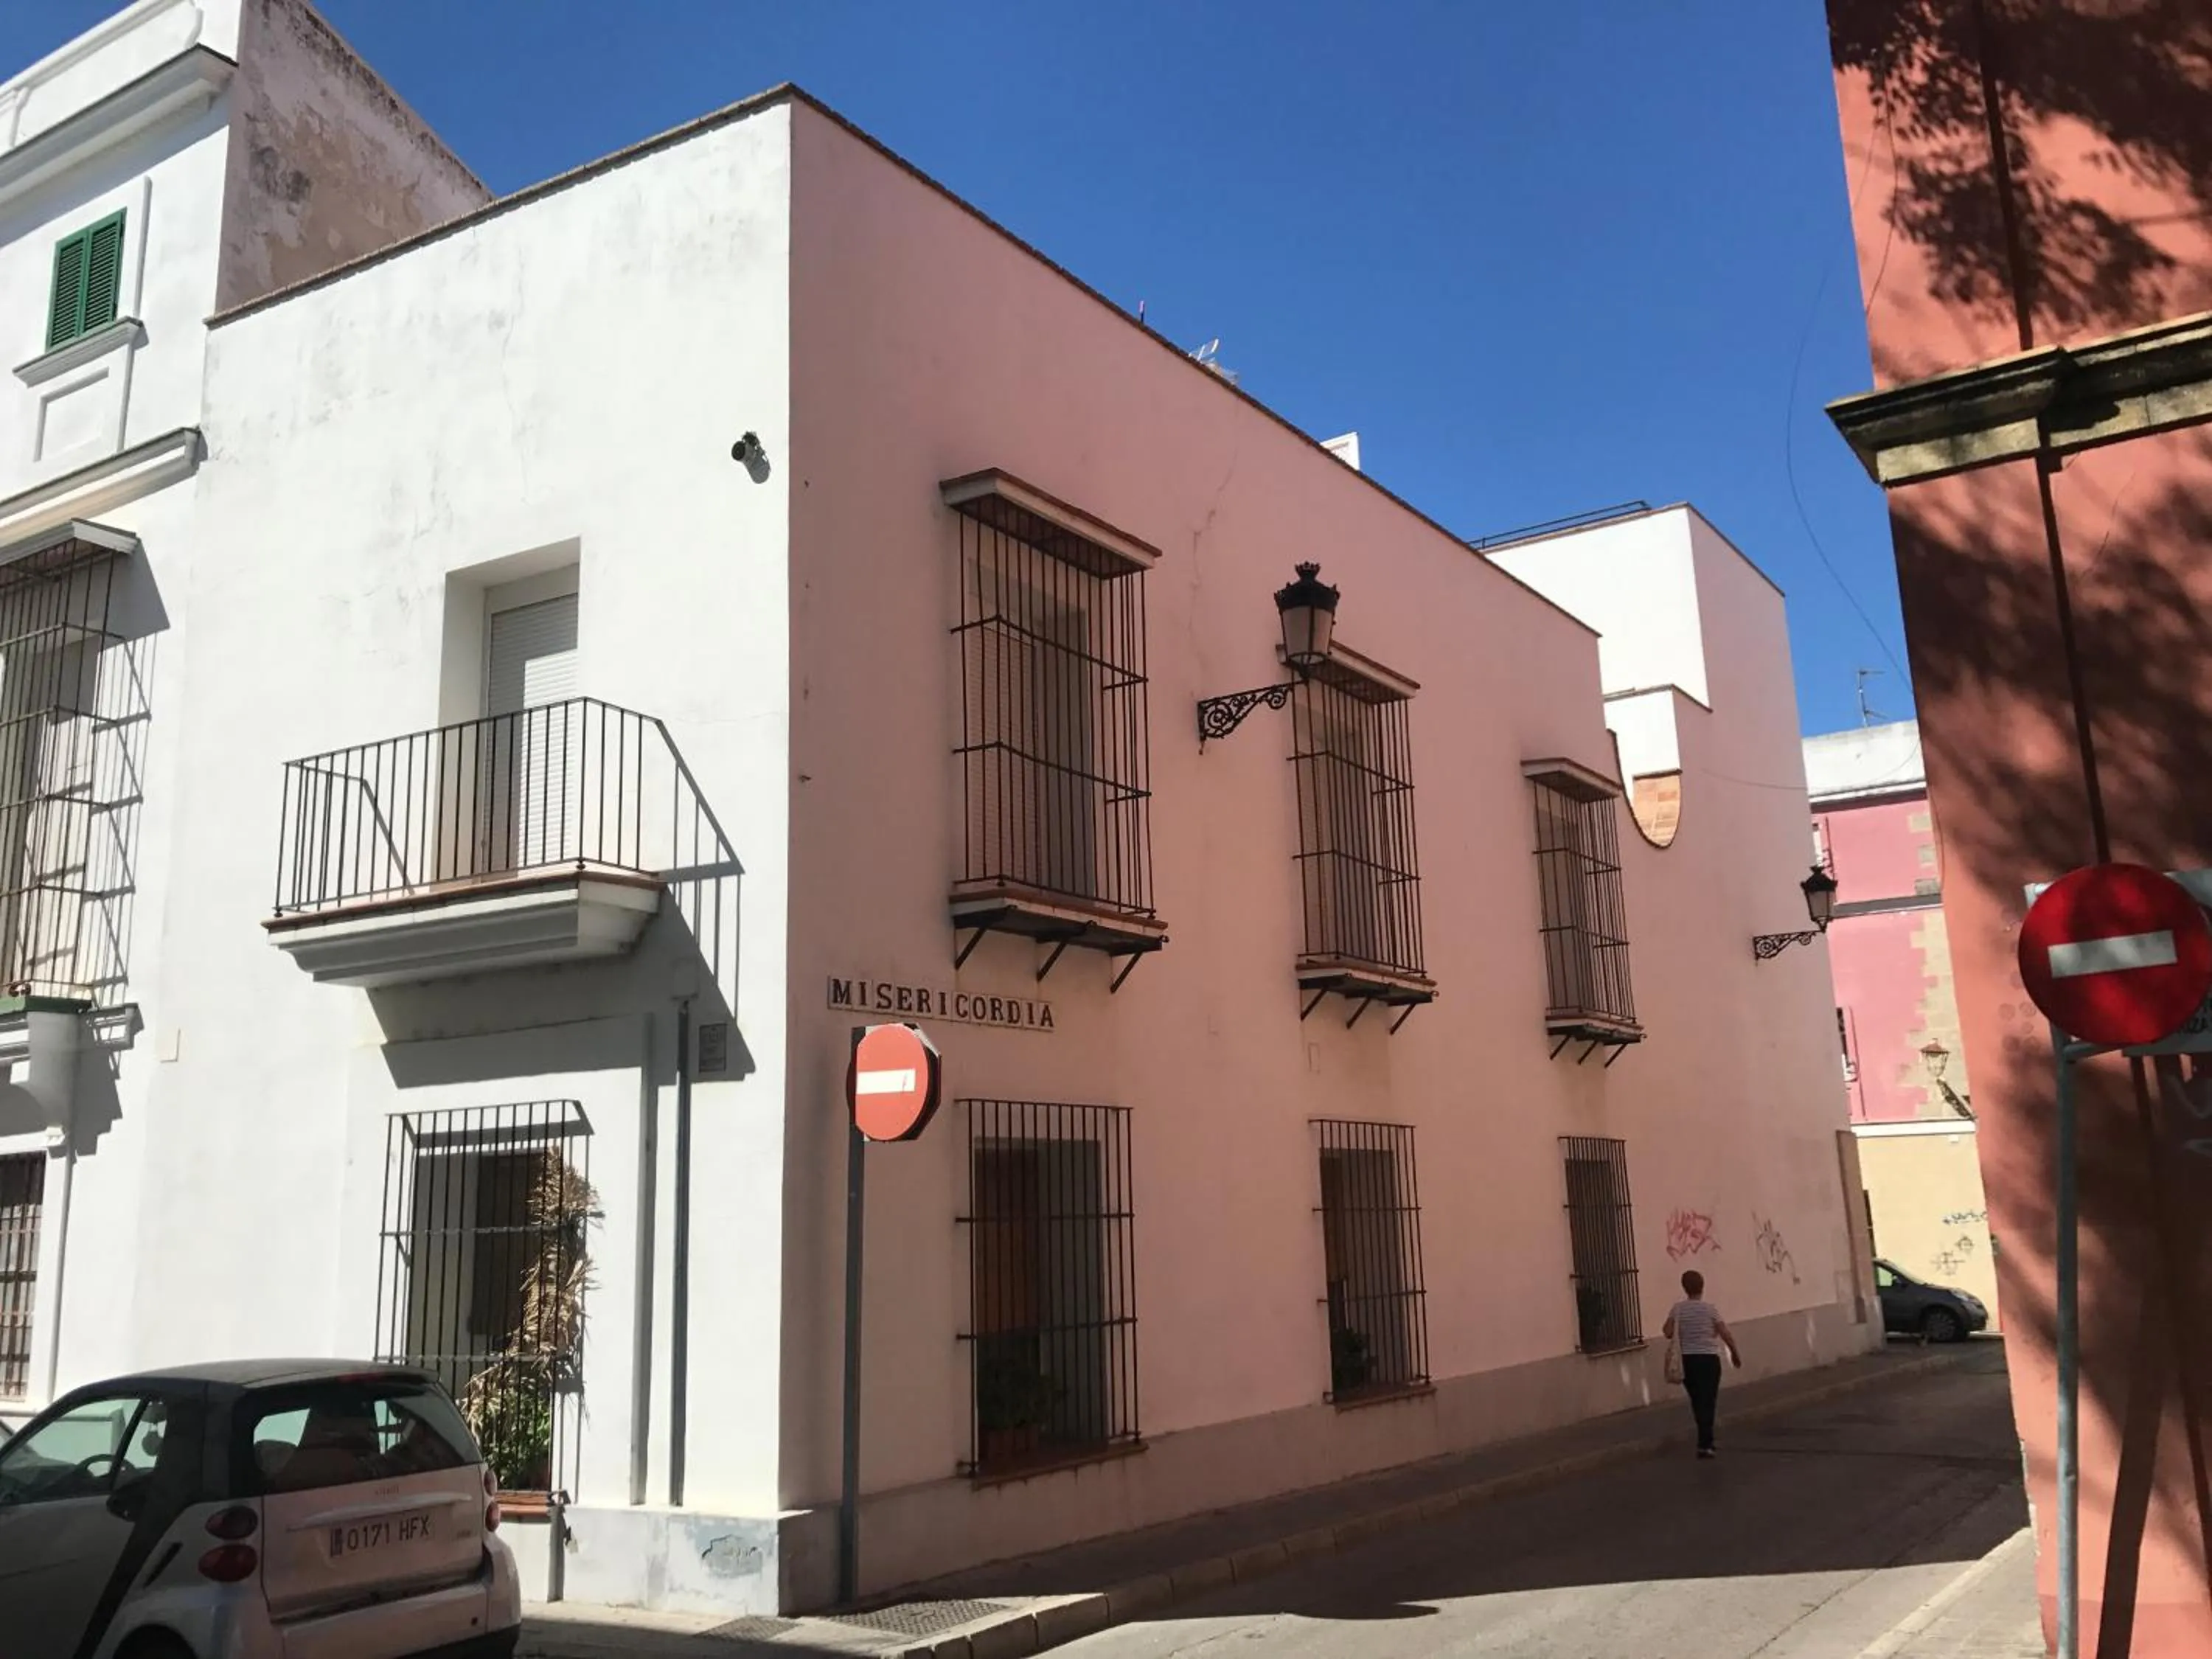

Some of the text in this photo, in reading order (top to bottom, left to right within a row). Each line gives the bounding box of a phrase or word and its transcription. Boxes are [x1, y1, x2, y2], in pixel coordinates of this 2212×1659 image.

[832, 978, 1054, 1027] MISERICORDIA
[347, 1522, 390, 1551] 0171
[400, 1515, 430, 1542] HFX
